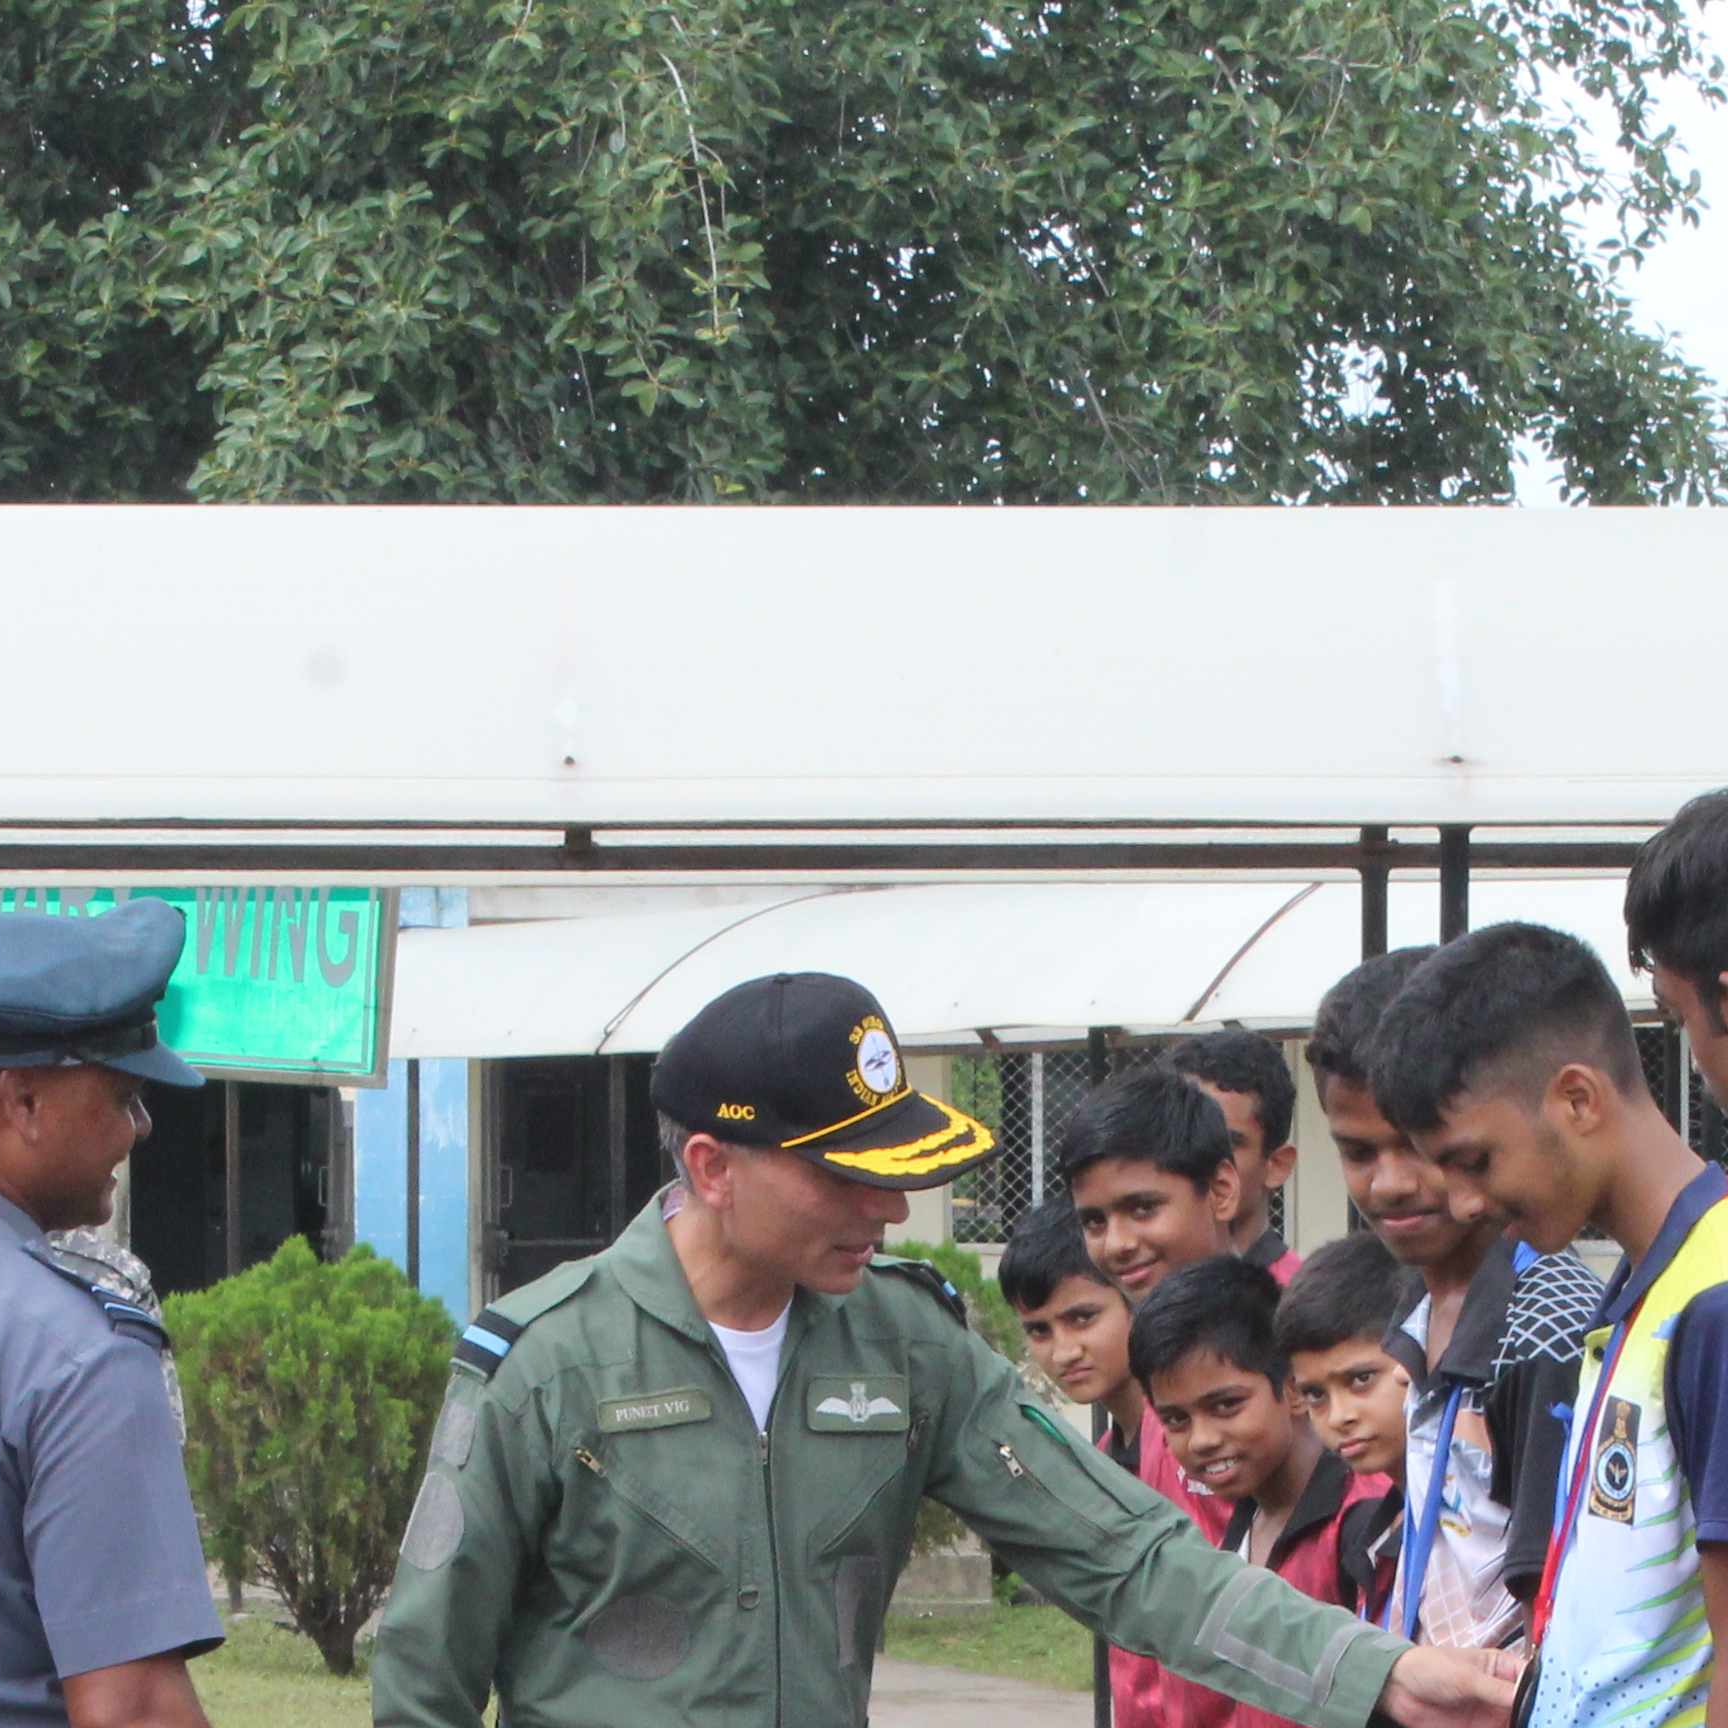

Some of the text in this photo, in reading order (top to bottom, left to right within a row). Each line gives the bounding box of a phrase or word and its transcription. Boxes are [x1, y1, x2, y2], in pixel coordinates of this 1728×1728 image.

[196, 887, 359, 987] WING
[716, 1102, 756, 1120] AOC
[664, 1400, 690, 1415] VIG
